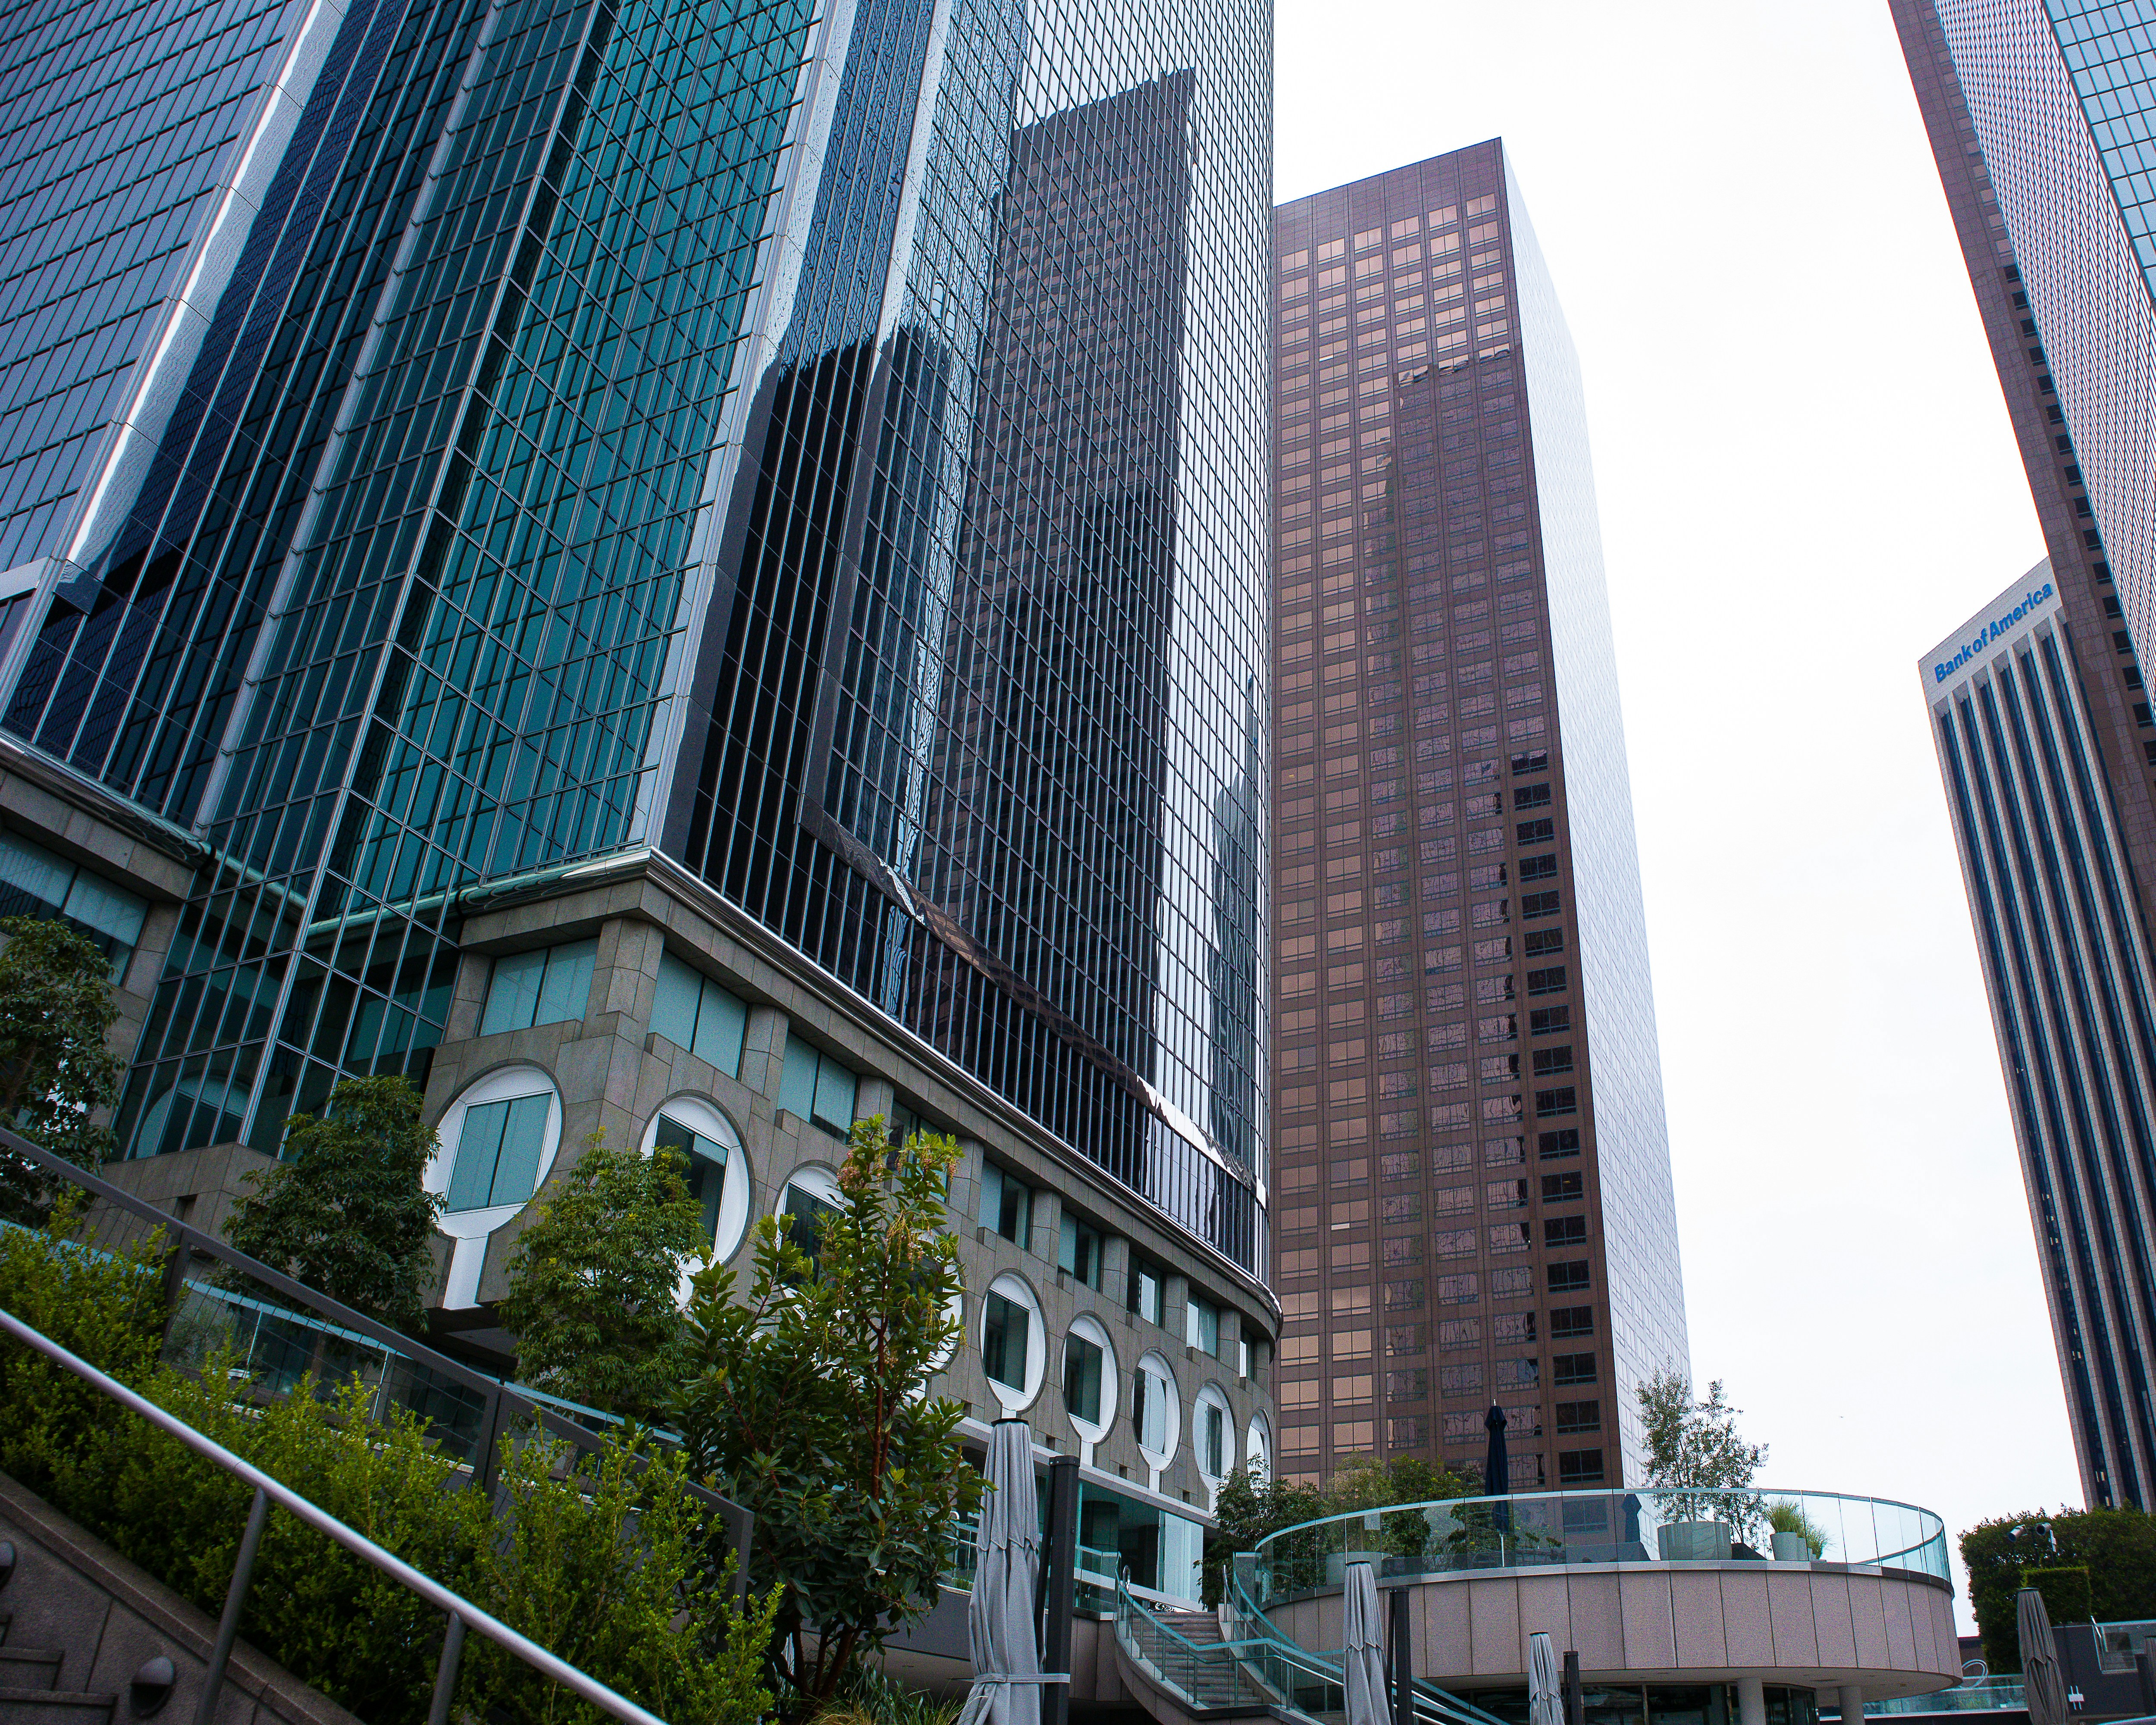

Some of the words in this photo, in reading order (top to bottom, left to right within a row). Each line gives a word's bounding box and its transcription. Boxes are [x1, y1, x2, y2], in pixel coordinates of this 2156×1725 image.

[1934, 645, 1973, 683] Bank
[1973, 628, 1988, 652] of
[1990, 583, 2053, 641] America
